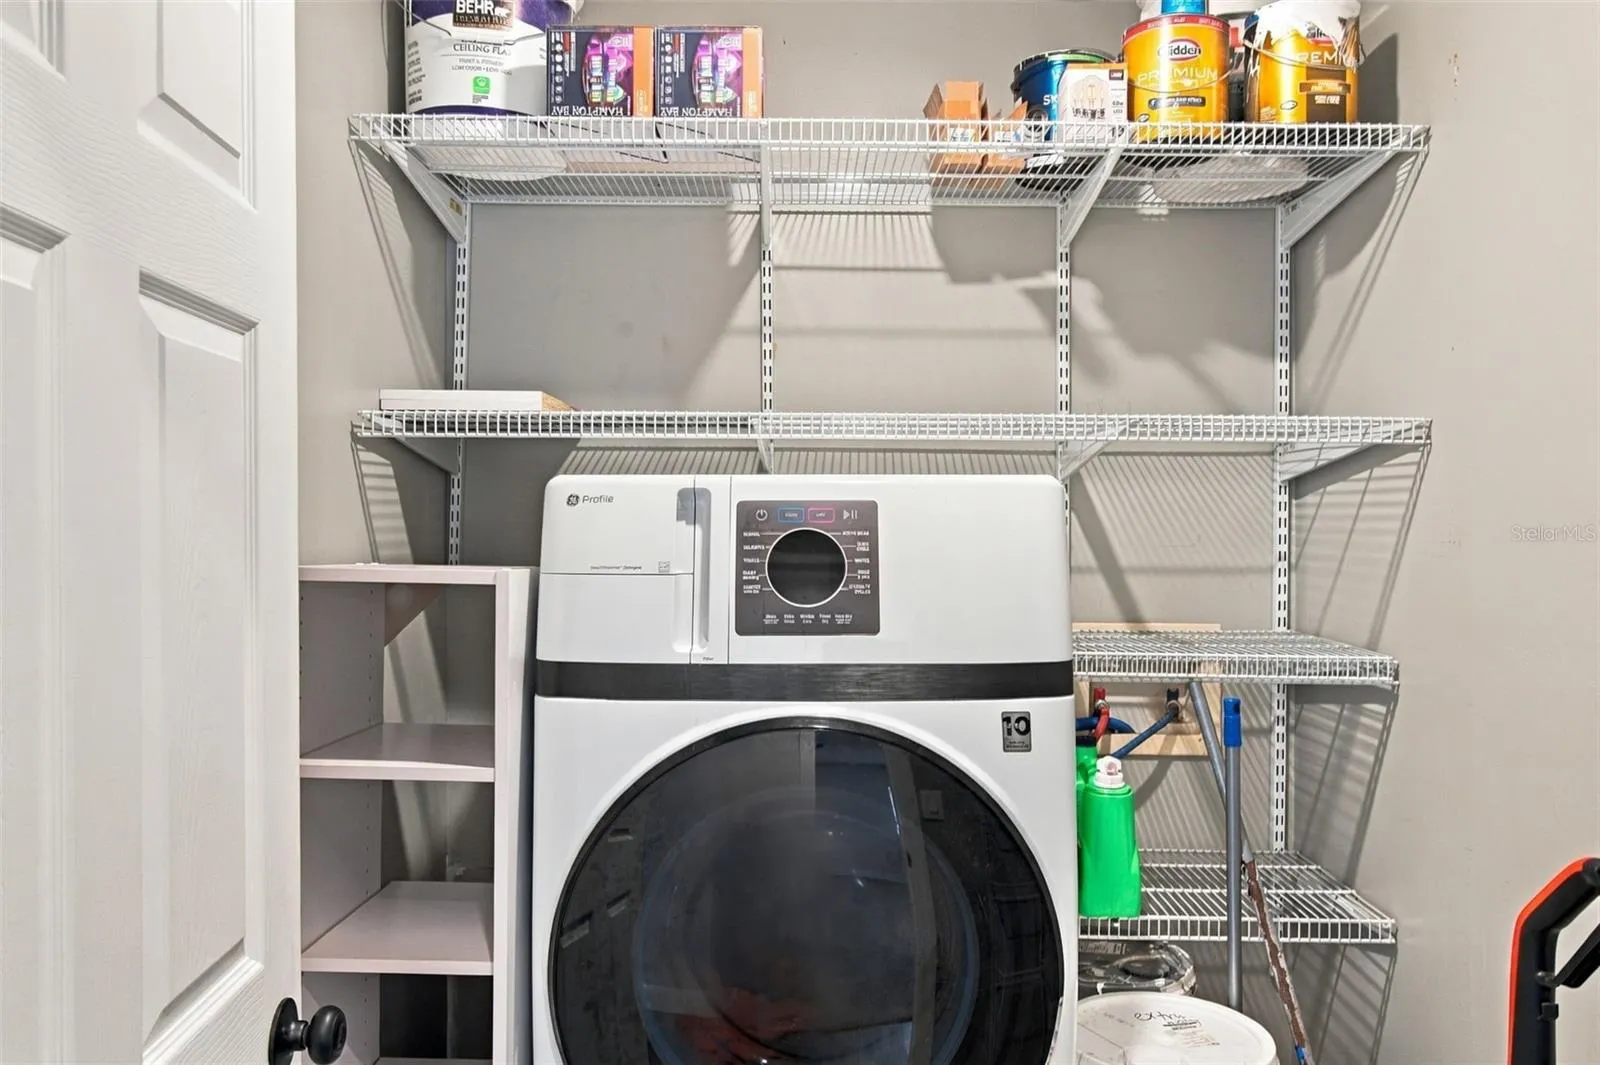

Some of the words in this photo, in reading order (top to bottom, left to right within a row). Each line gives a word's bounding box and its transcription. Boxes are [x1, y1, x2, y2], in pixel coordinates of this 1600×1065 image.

[456, 0, 494, 15] BEHR
[453, 43, 490, 53] CEILING
[492, 46, 511, 56] FLA
[1158, 45, 1202, 56] idden
[551, 106, 570, 116] BAY
[575, 106, 624, 117] HAMPTON
[660, 107, 681, 117] BAY
[681, 107, 733, 117] HAMPTON
[582, 494, 614, 504] Profile
[1002, 716, 1031, 736] 10
